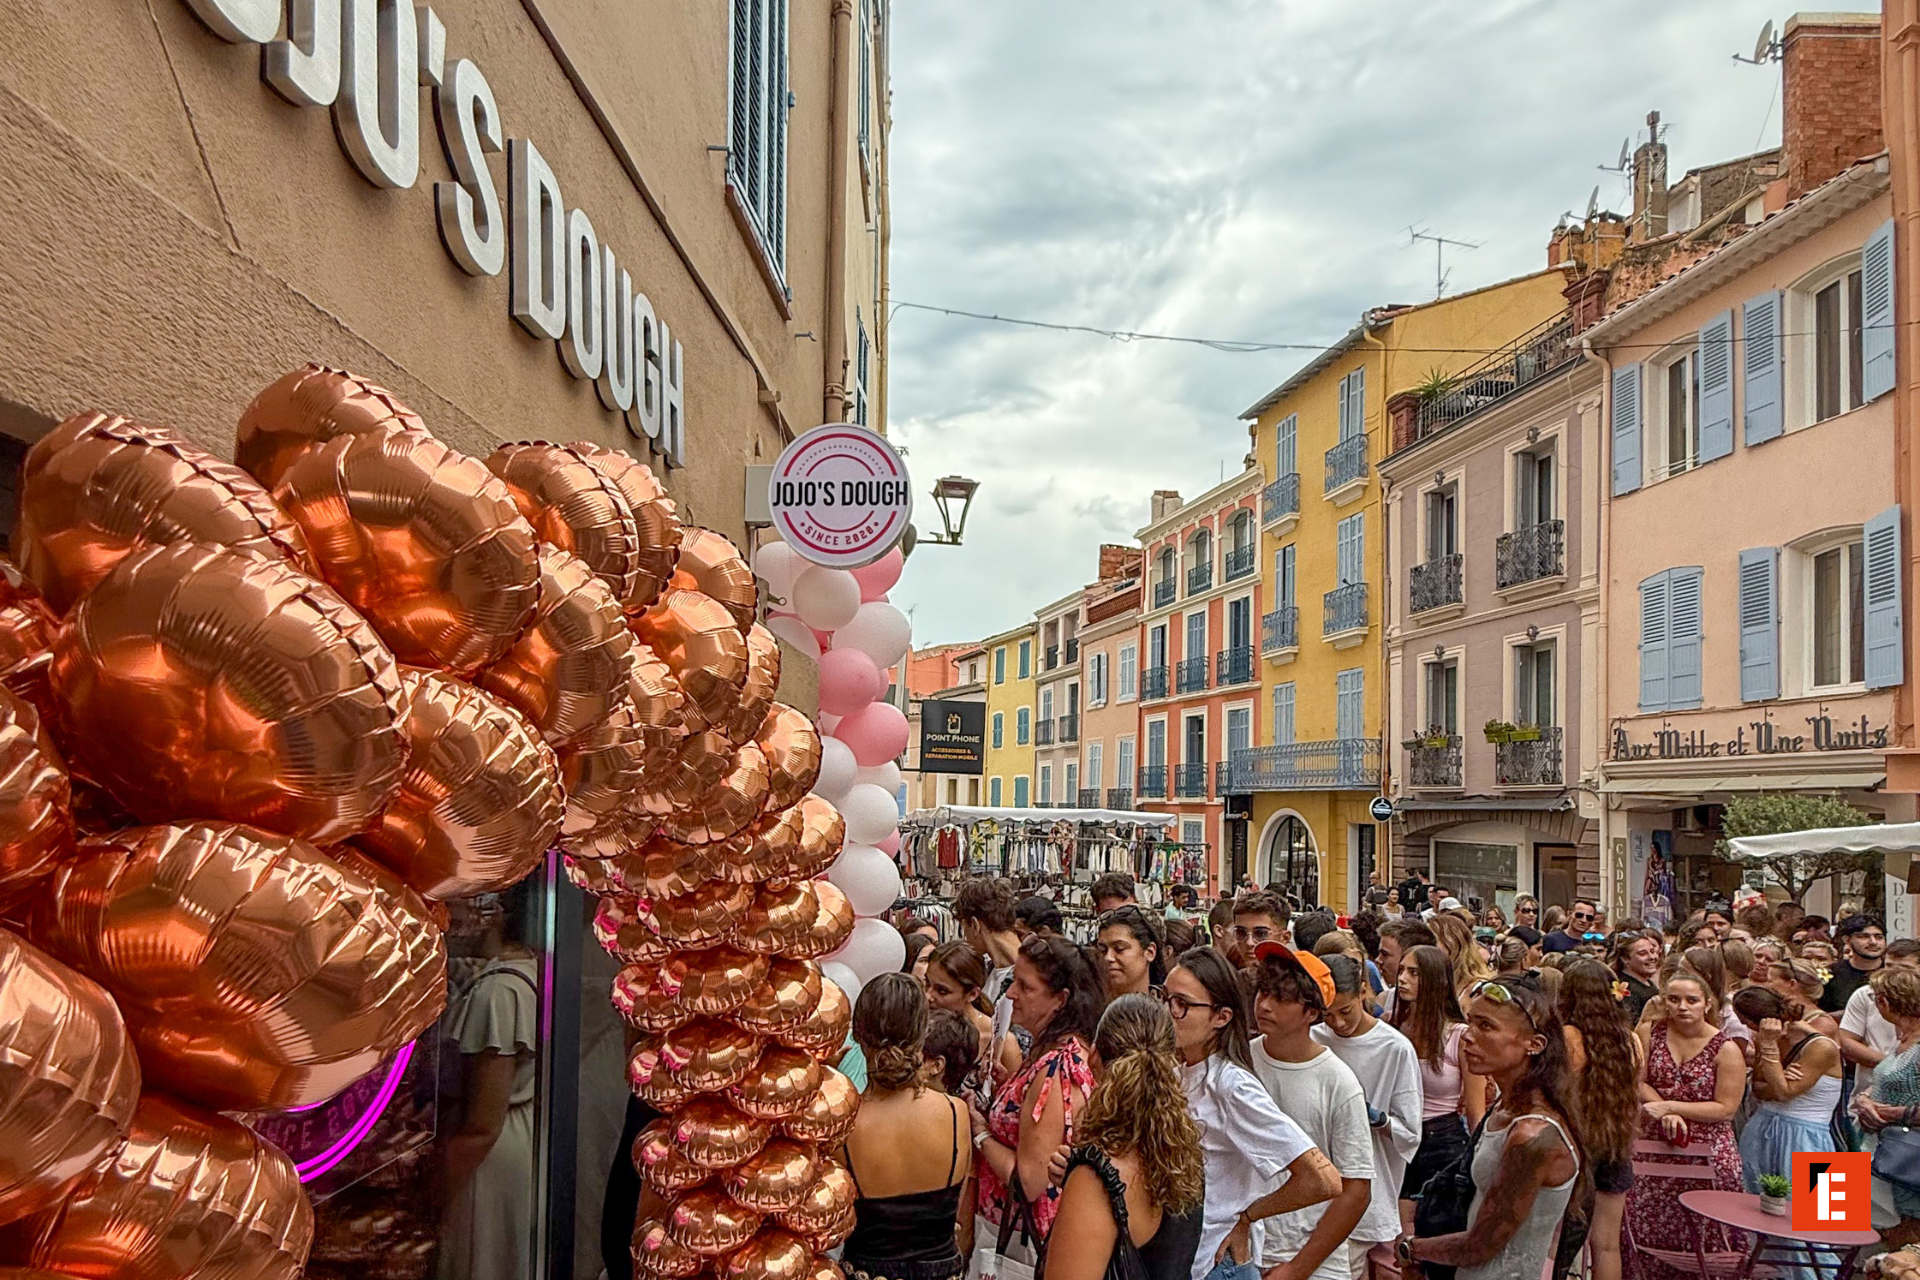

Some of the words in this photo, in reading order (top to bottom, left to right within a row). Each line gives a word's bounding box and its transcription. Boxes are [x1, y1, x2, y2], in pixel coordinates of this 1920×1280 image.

[508, 138, 684, 468] DOUGH
[772, 481, 836, 507] JOJO'S
[841, 480, 908, 506] DOUGH
[804, 525, 840, 546] SINCE
[844, 525, 874, 545] 2020
[926, 734, 951, 742] POINT
[952, 735, 980, 743] PHONE
[1612, 727, 1653, 761] Aux
[1653, 729, 1719, 759] Mille
[1727, 726, 1748, 756] et
[1749, 721, 1804, 754] Une
[1805, 714, 1889, 751] Nuits
[1893, 882, 1906, 940] DÉC
